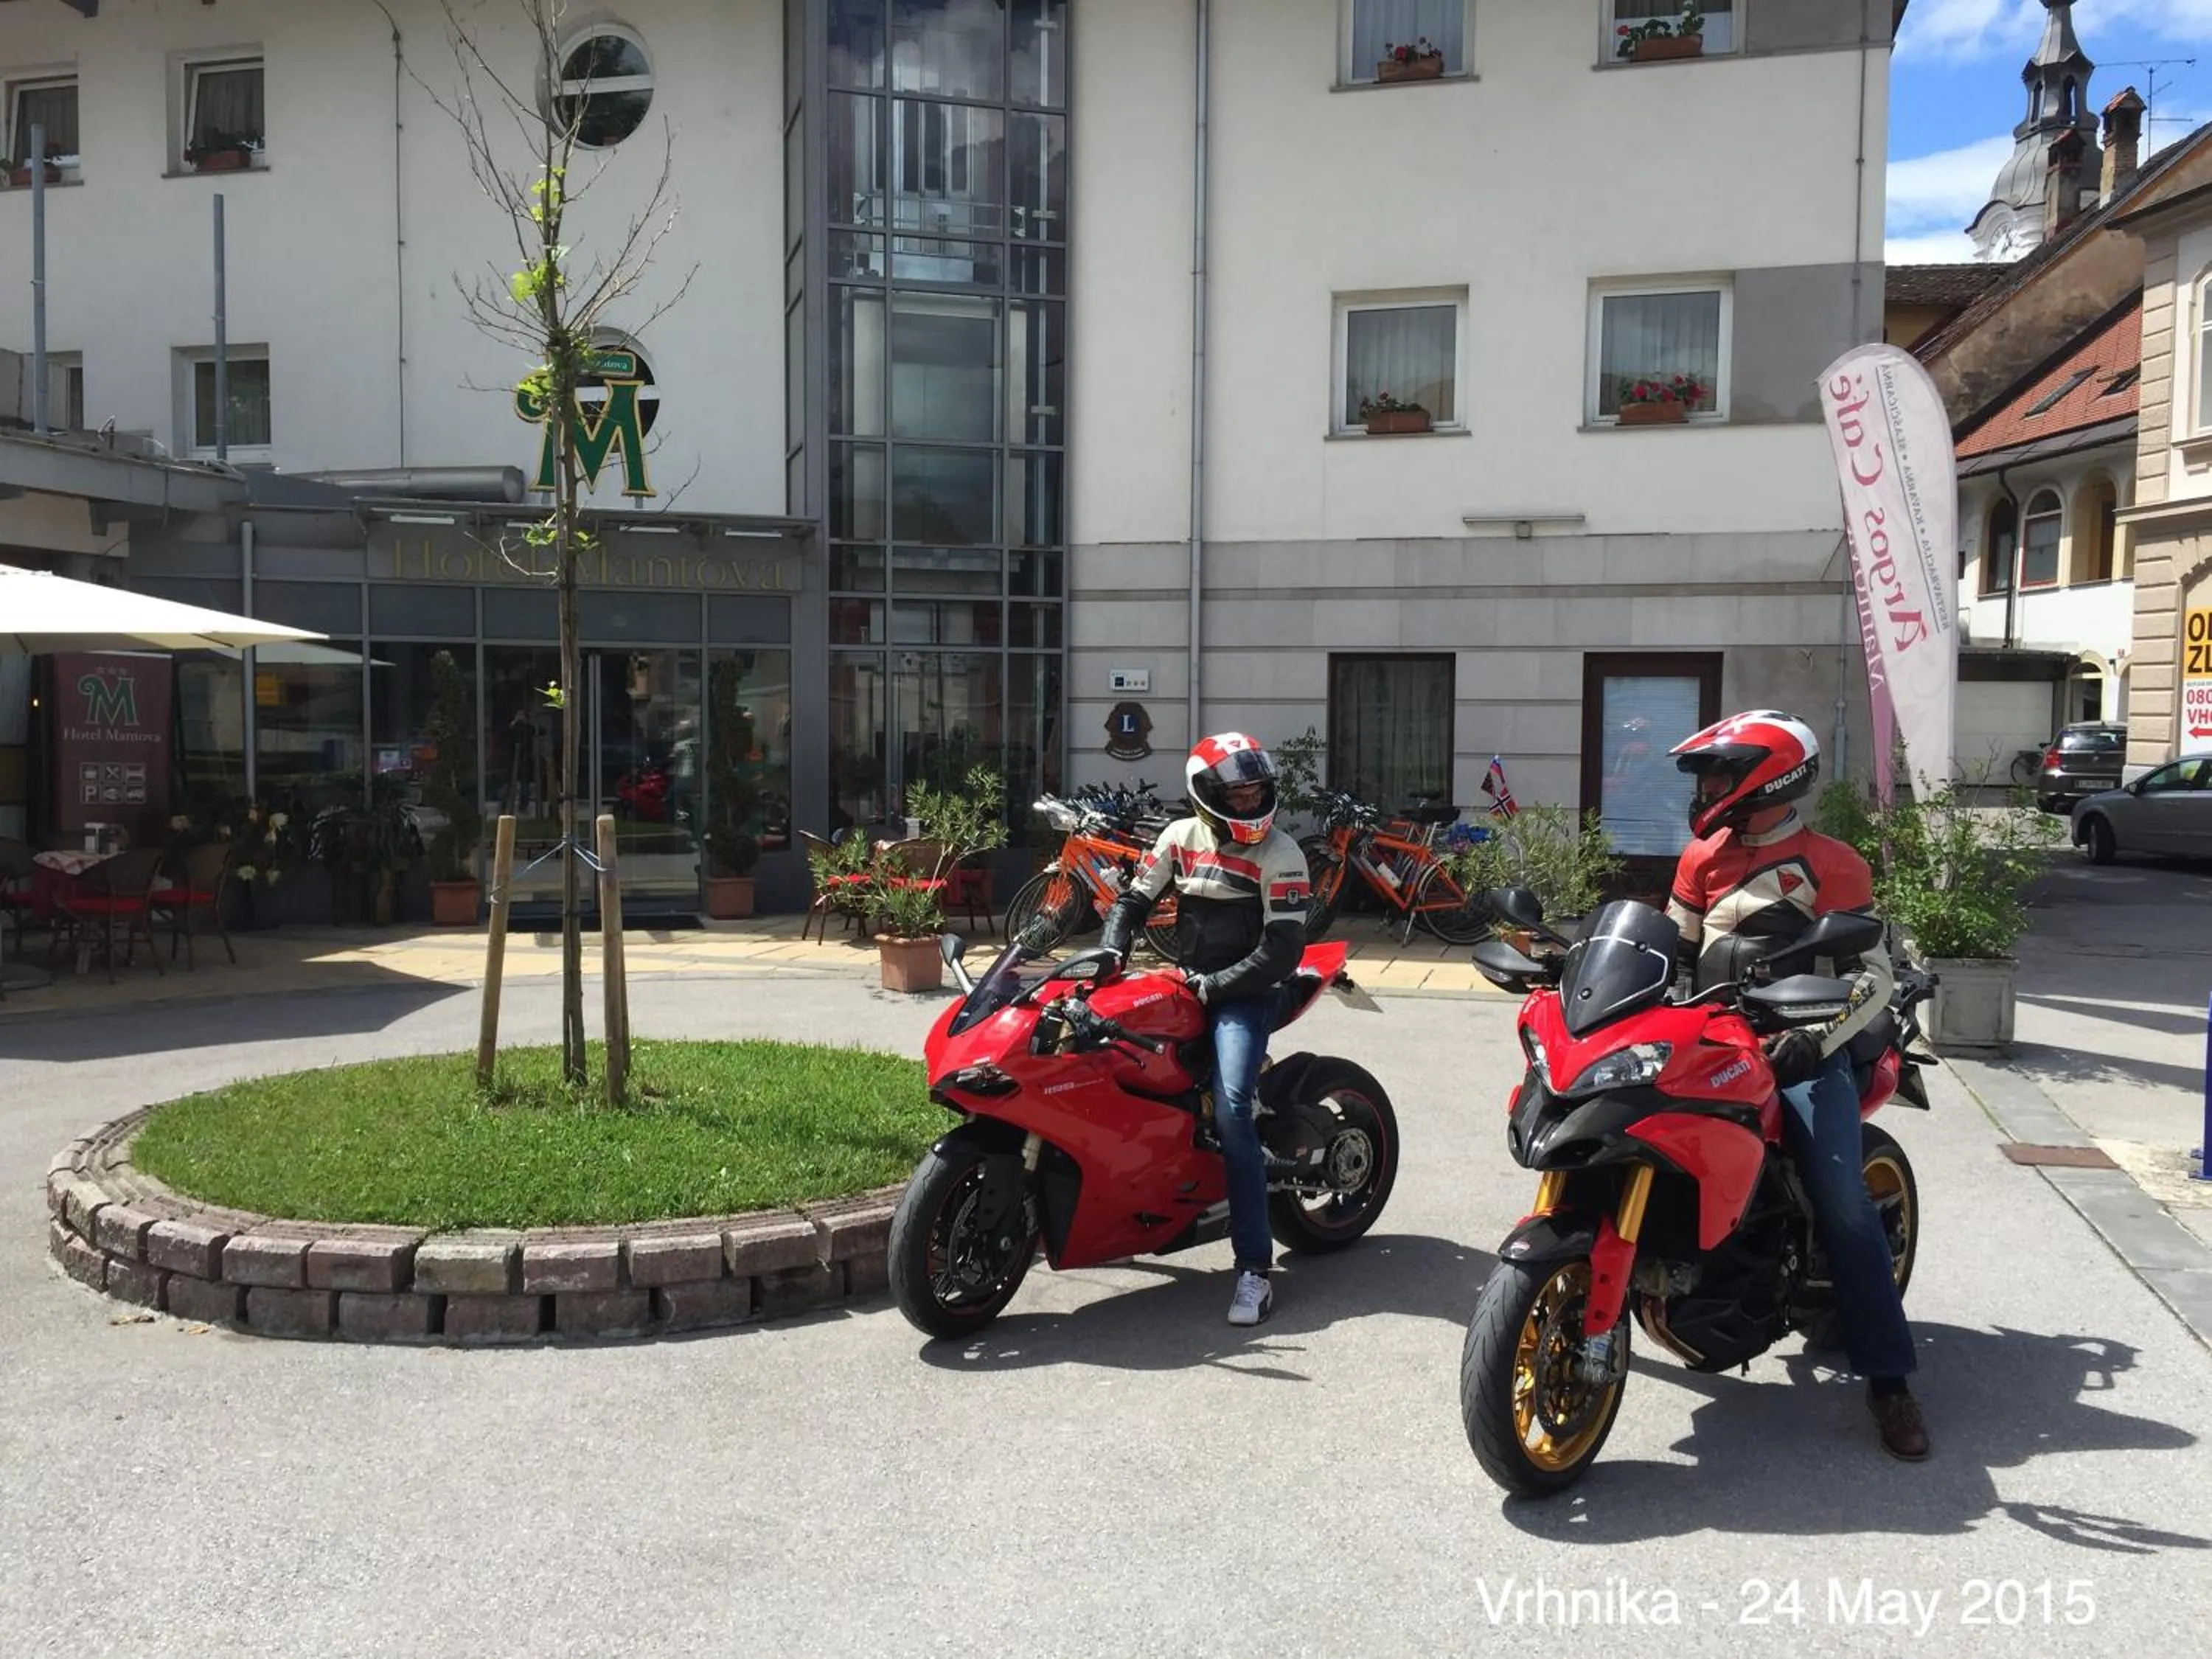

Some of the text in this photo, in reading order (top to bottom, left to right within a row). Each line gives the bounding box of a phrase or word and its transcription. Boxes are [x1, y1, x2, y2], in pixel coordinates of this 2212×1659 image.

[515, 369, 656, 497] M
[392, 538, 540, 582] Hotel
[77, 674, 140, 726] M
[1121, 714, 1135, 732] L
[2187, 708, 2212, 725] VH
[64, 727, 161, 742] Hotel Mantova
[1764, 765, 1807, 795] DUCATI
[1711, 1060, 1751, 1088] DUCATI
